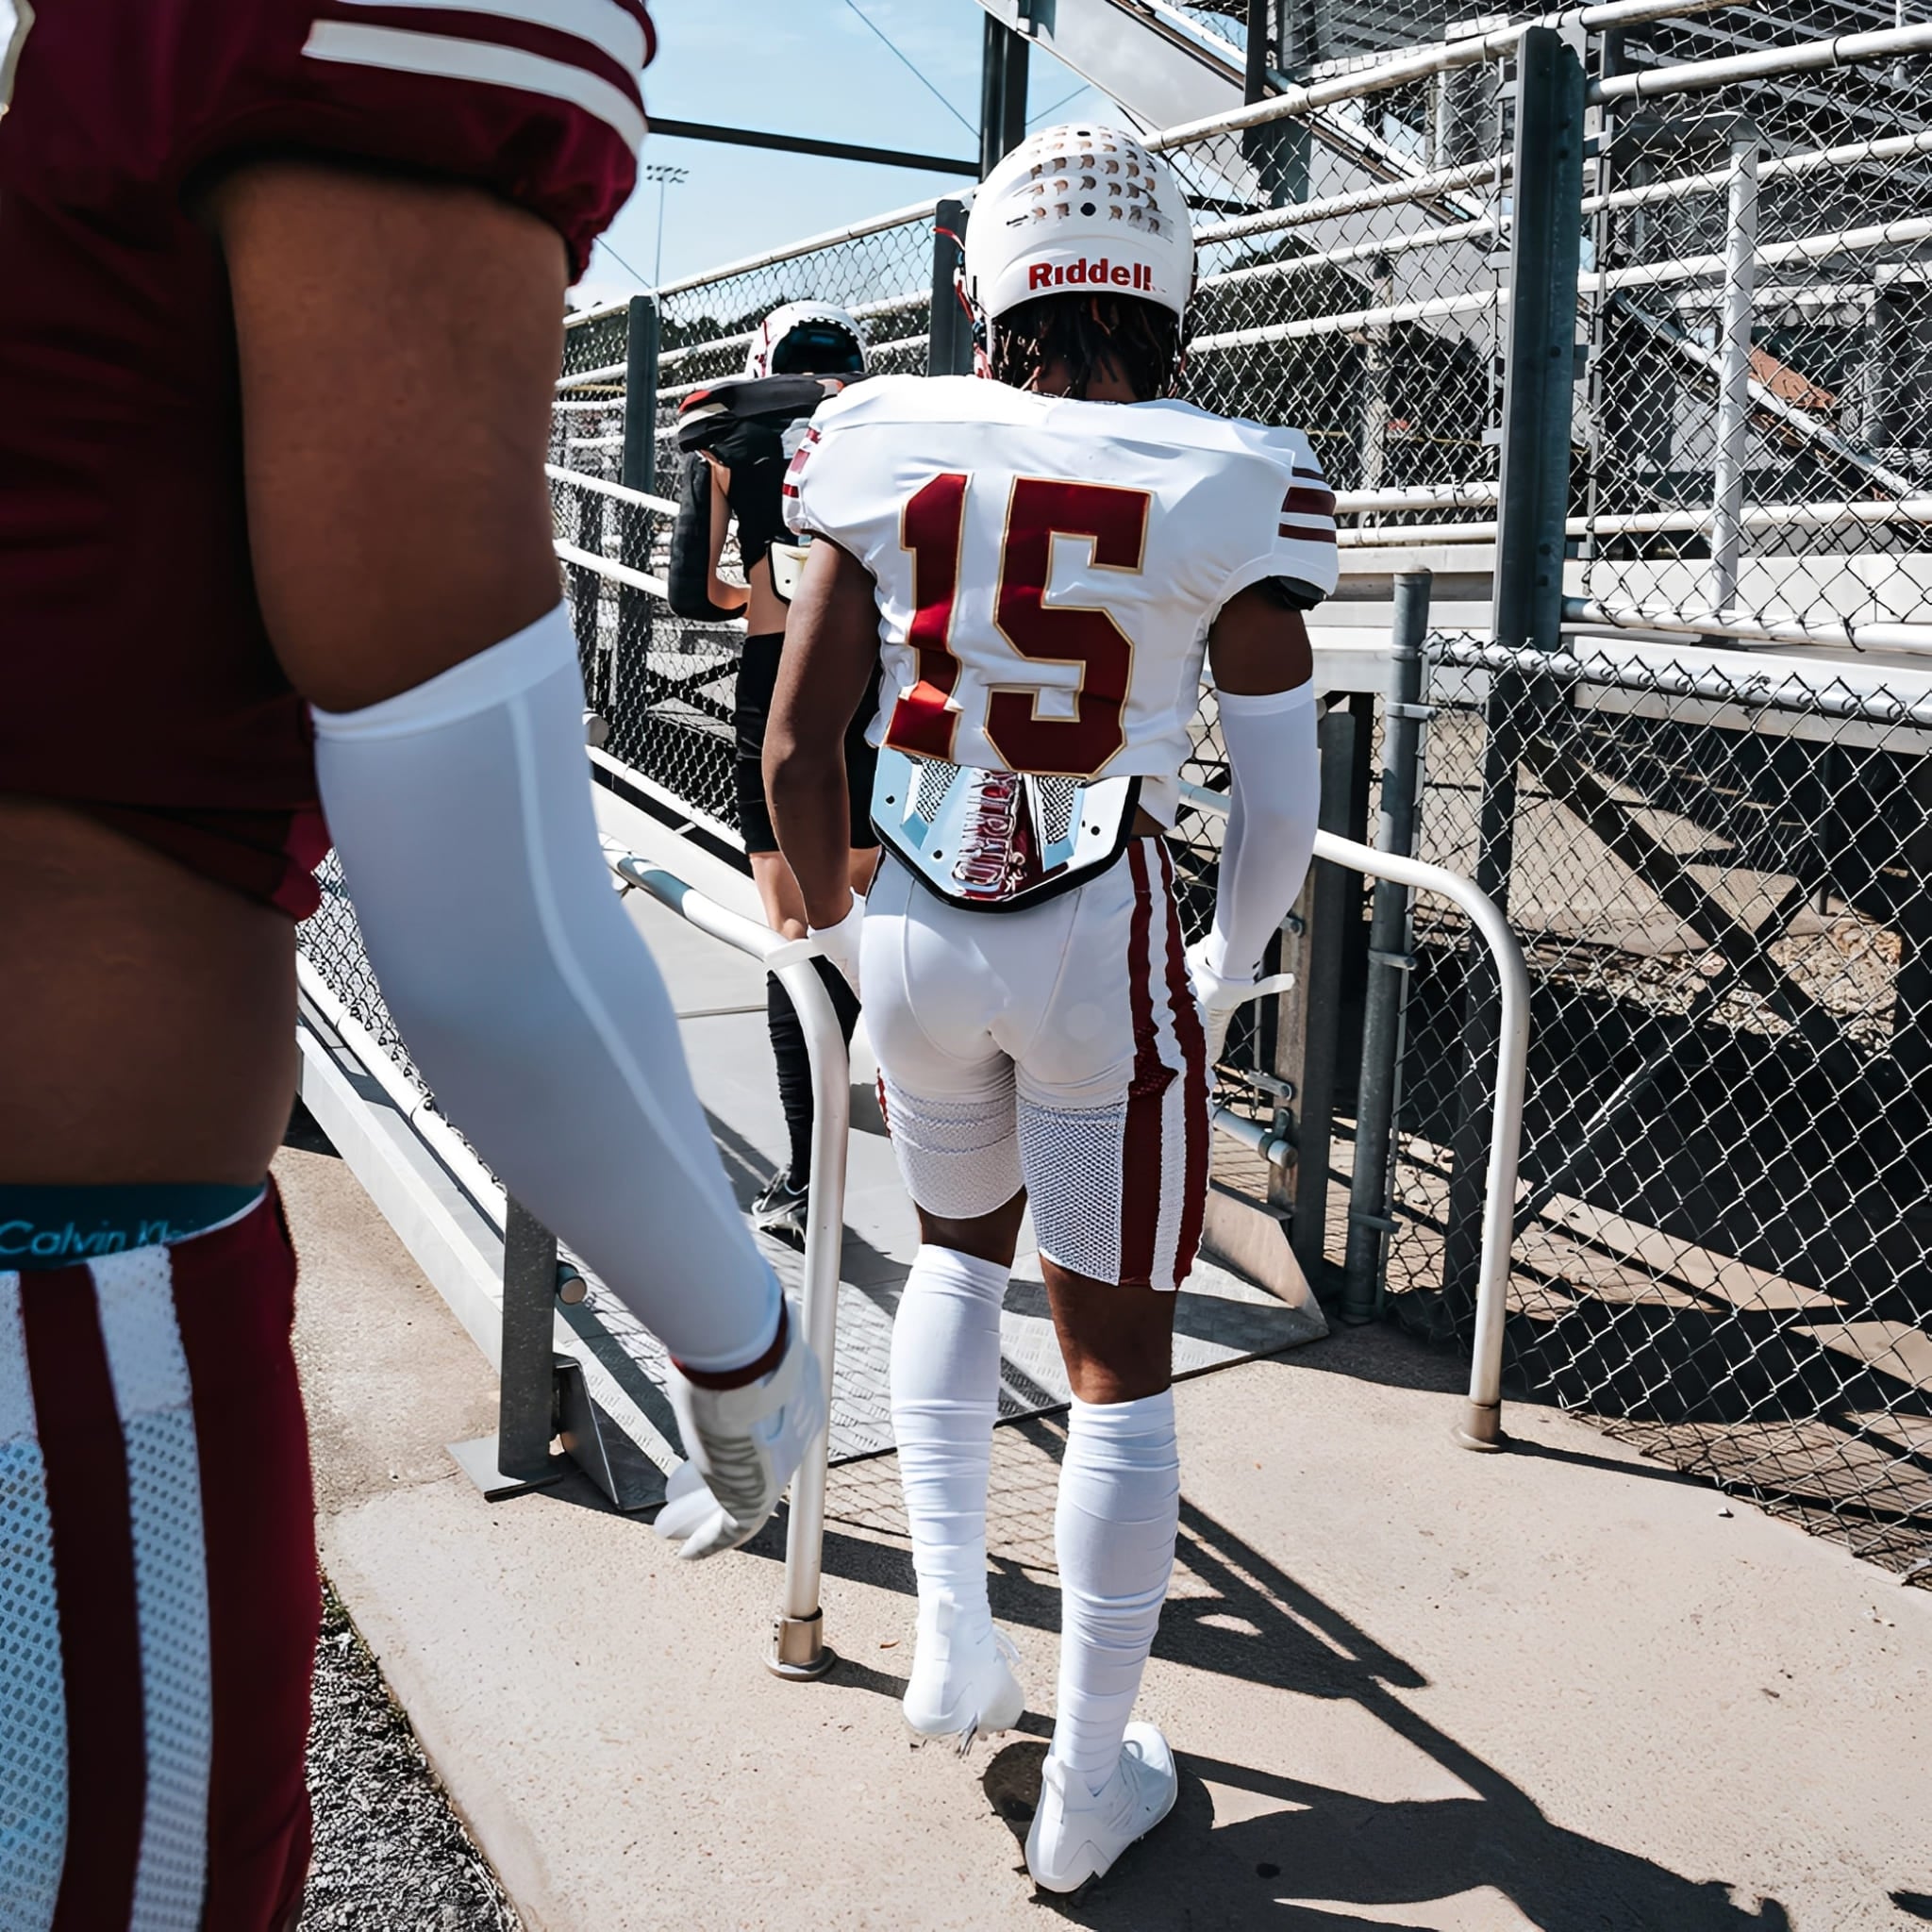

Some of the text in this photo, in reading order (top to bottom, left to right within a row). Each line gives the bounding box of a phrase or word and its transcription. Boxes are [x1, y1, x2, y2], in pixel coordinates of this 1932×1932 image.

[1028, 258, 1152, 291] Riddell
[884, 472, 1153, 777] 15
[0, 1220, 126, 1256] Calvin
